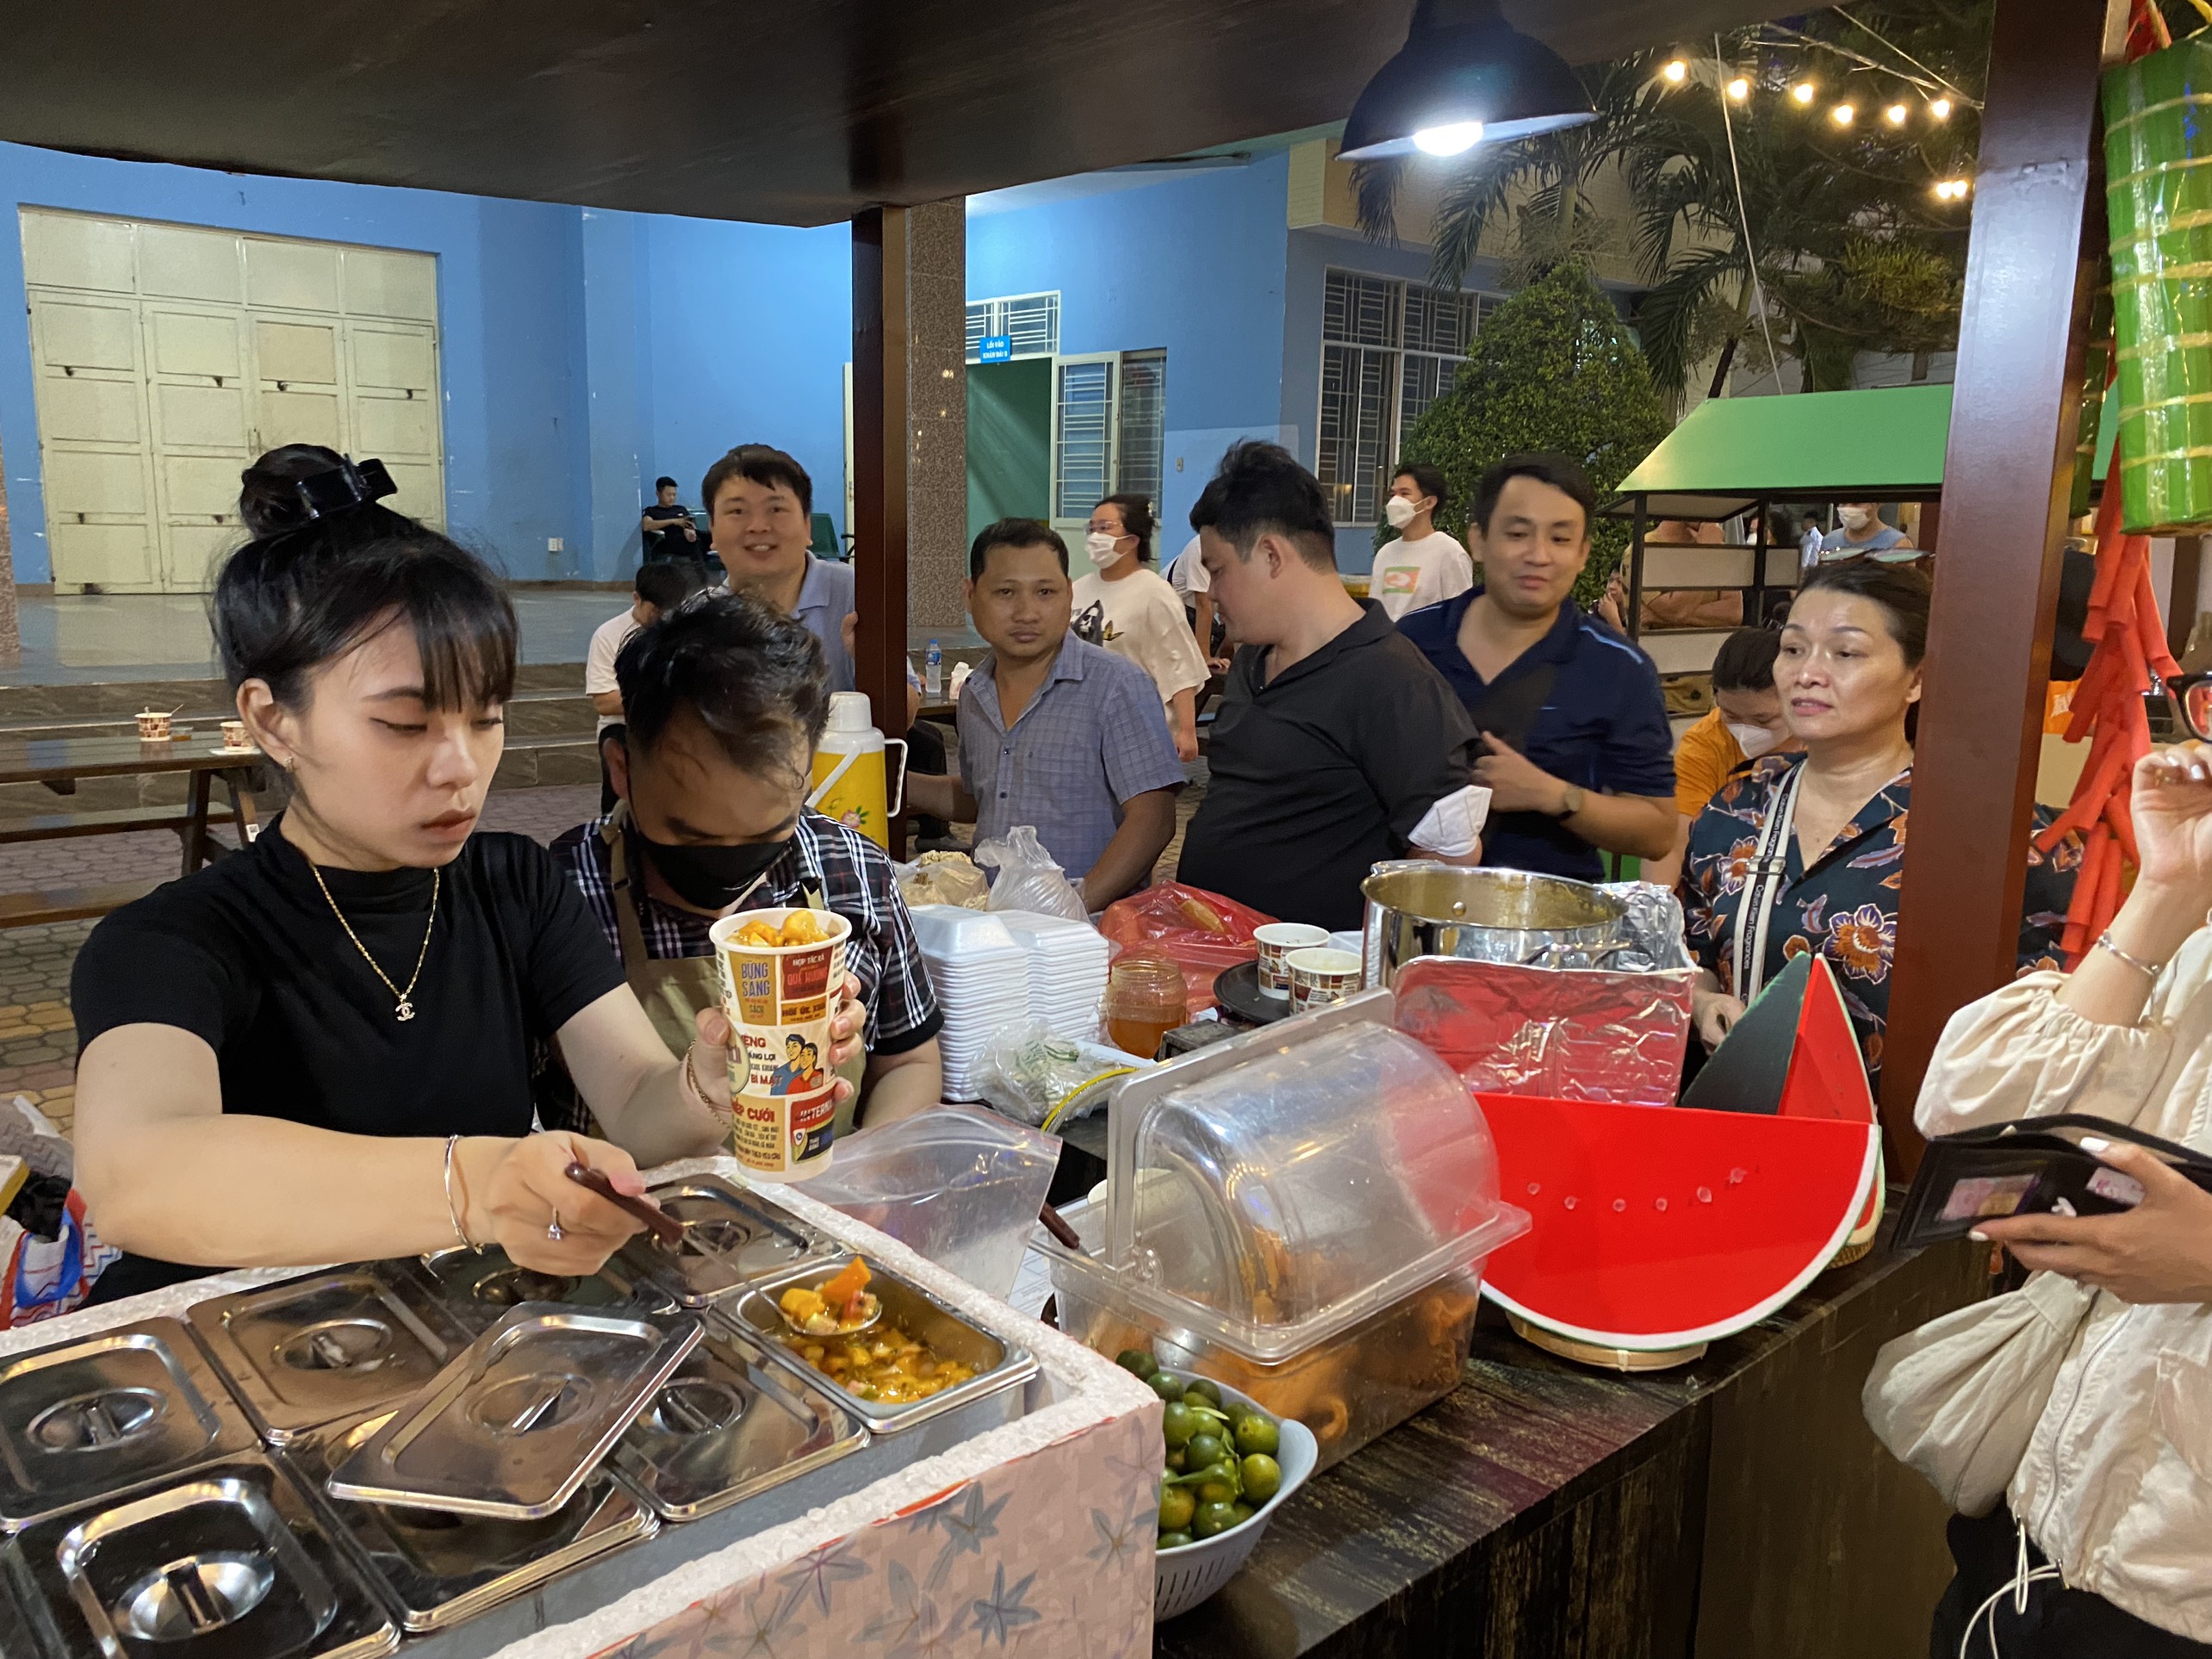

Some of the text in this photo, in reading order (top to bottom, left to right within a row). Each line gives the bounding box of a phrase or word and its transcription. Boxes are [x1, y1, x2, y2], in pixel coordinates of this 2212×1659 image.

[1743, 884, 1764, 970] Calvin Klein Fragrances
